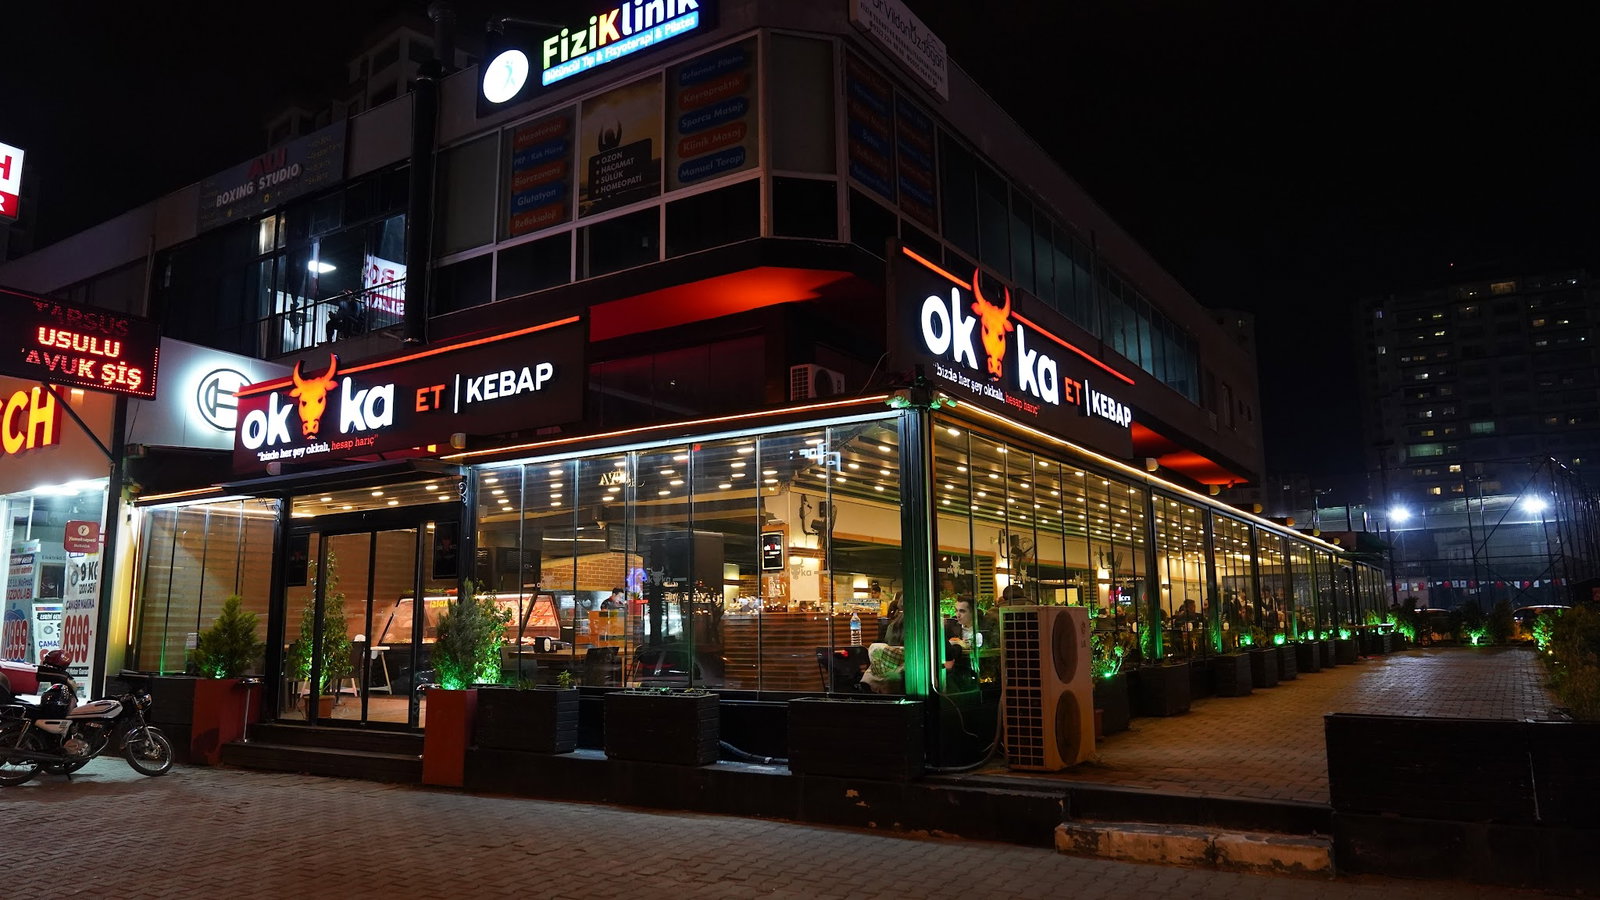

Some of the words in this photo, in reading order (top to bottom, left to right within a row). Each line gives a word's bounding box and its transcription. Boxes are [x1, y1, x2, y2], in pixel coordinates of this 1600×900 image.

[664, 15, 696, 36] Pilates
[681, 113, 711, 129] Sporcu
[683, 138, 709, 153] Klinik
[601, 151, 623, 163] OZON
[601, 157, 635, 174] HACAMAT
[680, 161, 713, 177] Manuel
[717, 154, 744, 169] Terapi
[216, 182, 254, 207] BOXING
[258, 163, 300, 190] STUDIO
[601, 169, 624, 184] SÜLÜK
[517, 188, 557, 206] Glutatyon
[38, 326, 120, 358] USULU
[22, 348, 96, 379] AVUK
[101, 361, 142, 389] ŞİŞ
[415, 384, 445, 413] ET
[466, 362, 553, 404] KEBAP
[958, 372, 970, 388] her
[1005, 392, 1023, 411] hesap
[1064, 376, 1082, 406] ET
[1091, 389, 1132, 428] KEBAP
[0, 384, 56, 455] CH
[280, 449, 292, 459] her
[292, 447, 305, 459] şey
[331, 440, 353, 451] hesap
[80, 561, 87, 581] 9
